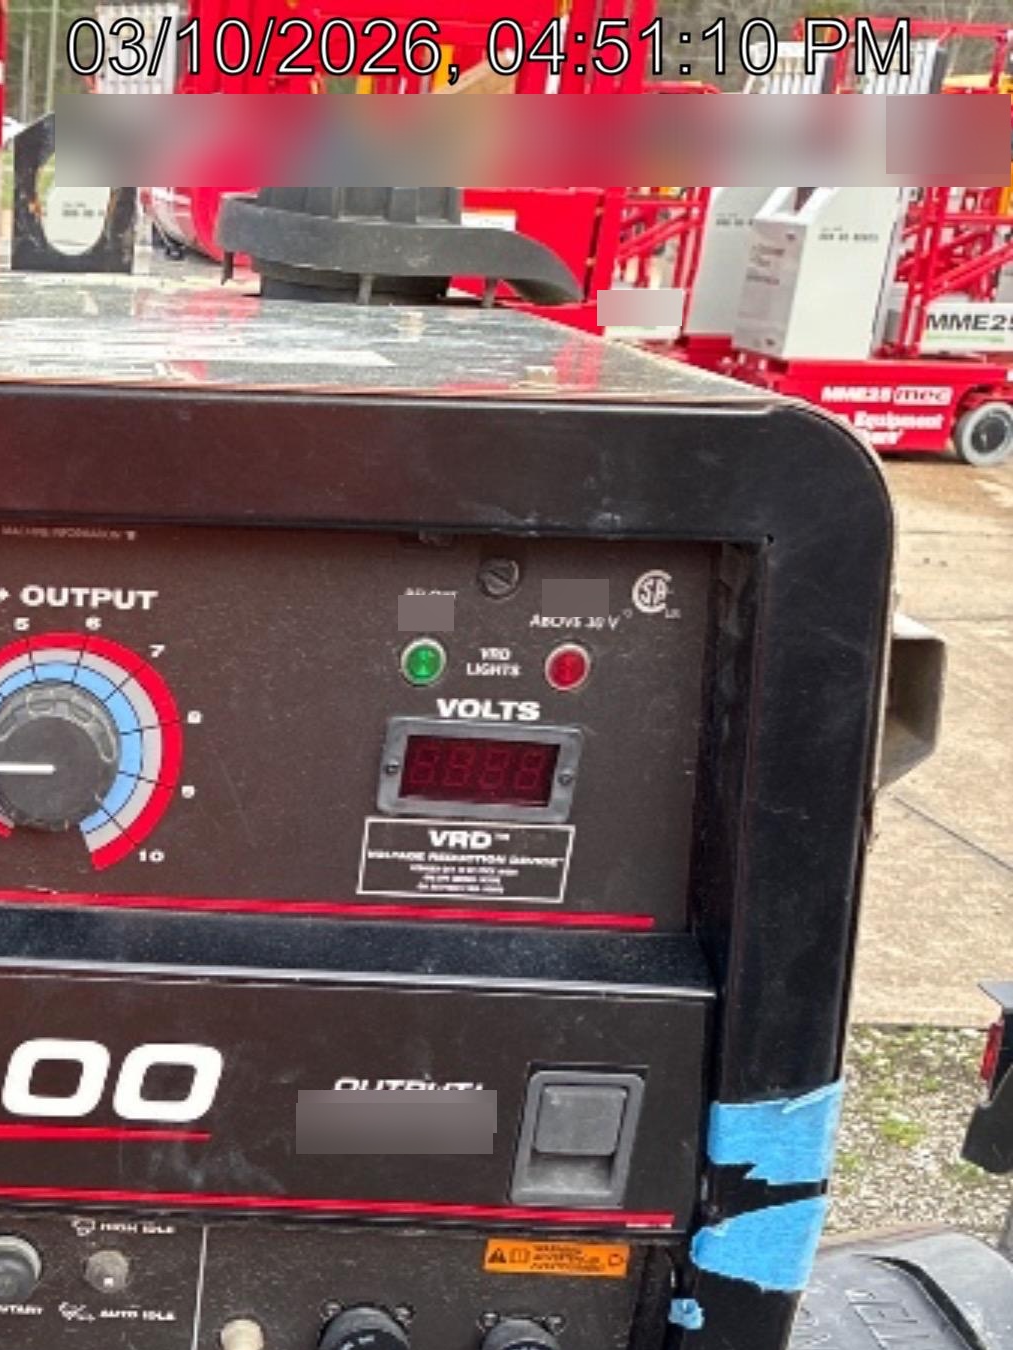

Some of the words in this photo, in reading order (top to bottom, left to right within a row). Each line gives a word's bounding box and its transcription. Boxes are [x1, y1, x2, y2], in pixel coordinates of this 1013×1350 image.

[927, 313, 1013, 331] MME2
[20, 585, 159, 610] OUTPUT
[14, 617, 30, 631] 5
[85, 617, 102, 631] 6
[149, 644, 166, 658] 7
[466, 663, 521, 677] LIGHTS
[436, 698, 541, 721] VOLTS
[139, 849, 165, 863] 10
